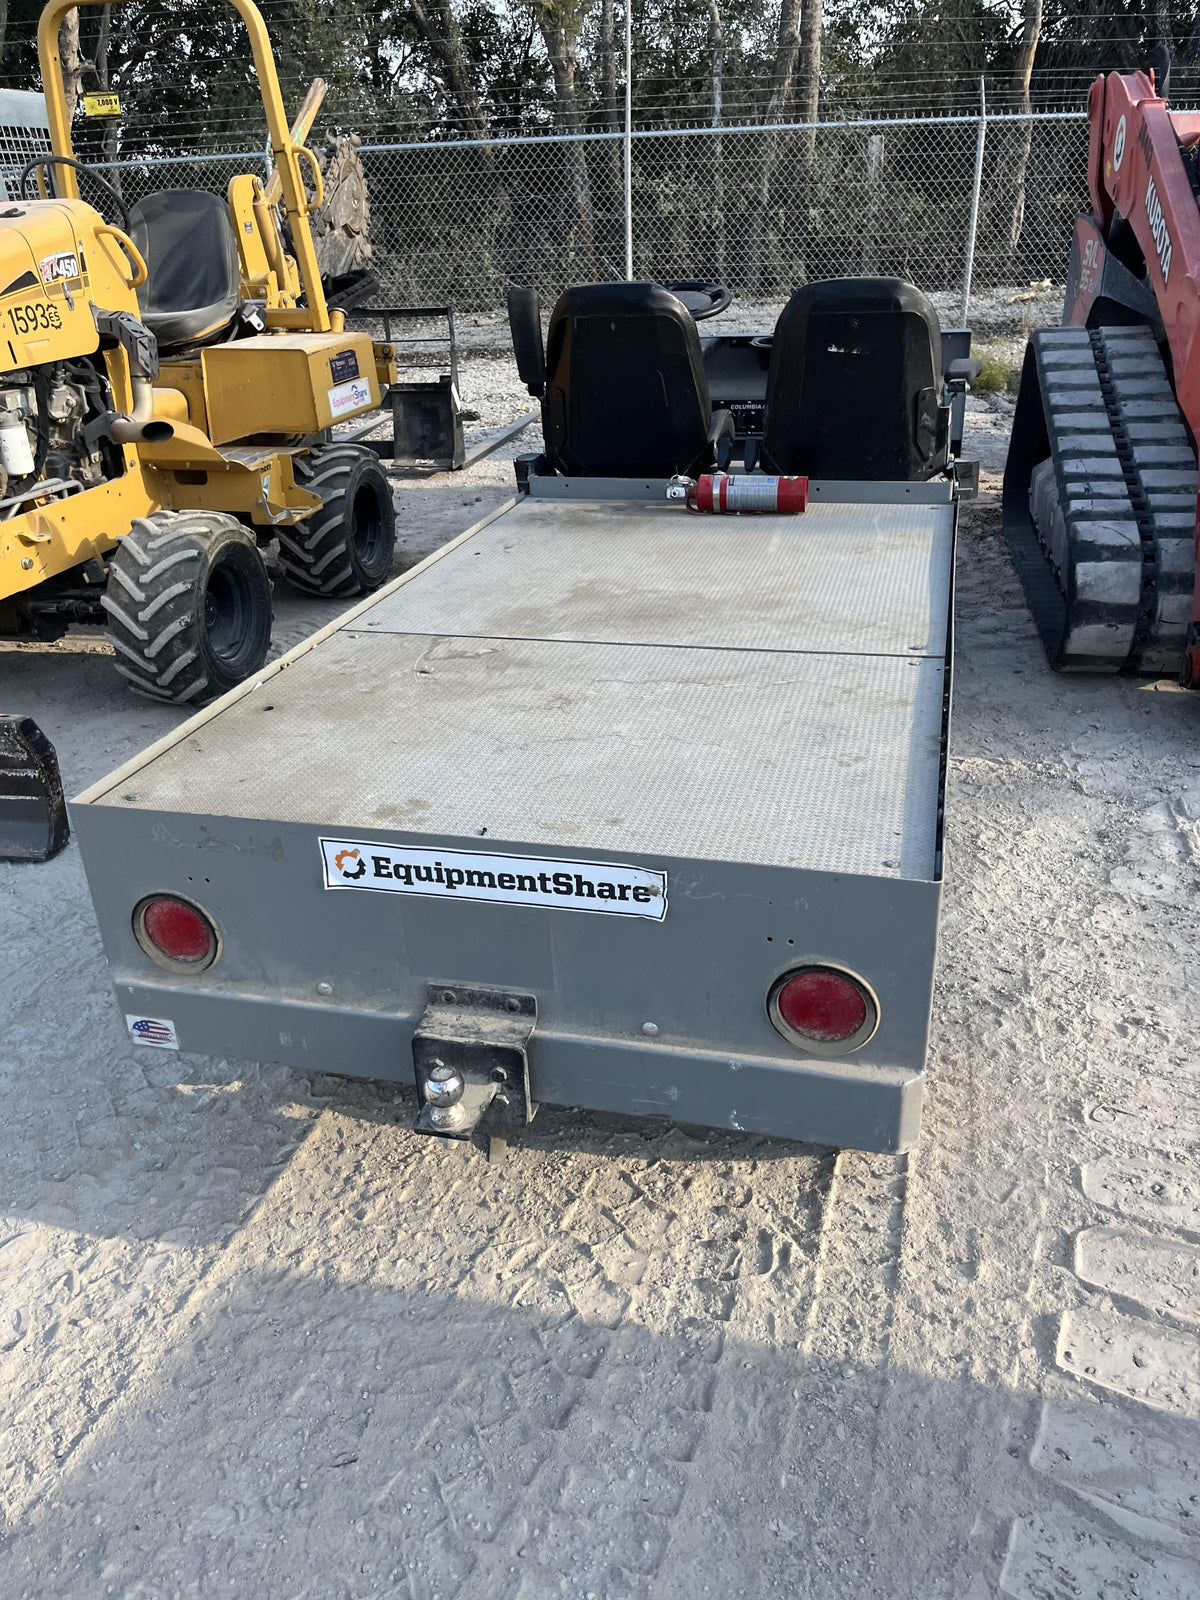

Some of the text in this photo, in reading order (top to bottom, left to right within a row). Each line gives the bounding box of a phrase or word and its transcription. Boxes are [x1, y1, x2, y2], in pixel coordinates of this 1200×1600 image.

[1145, 175, 1172, 284] KUBOTA
[8, 303, 49, 335] 1593
[371, 855, 651, 904] EquipmentShare
